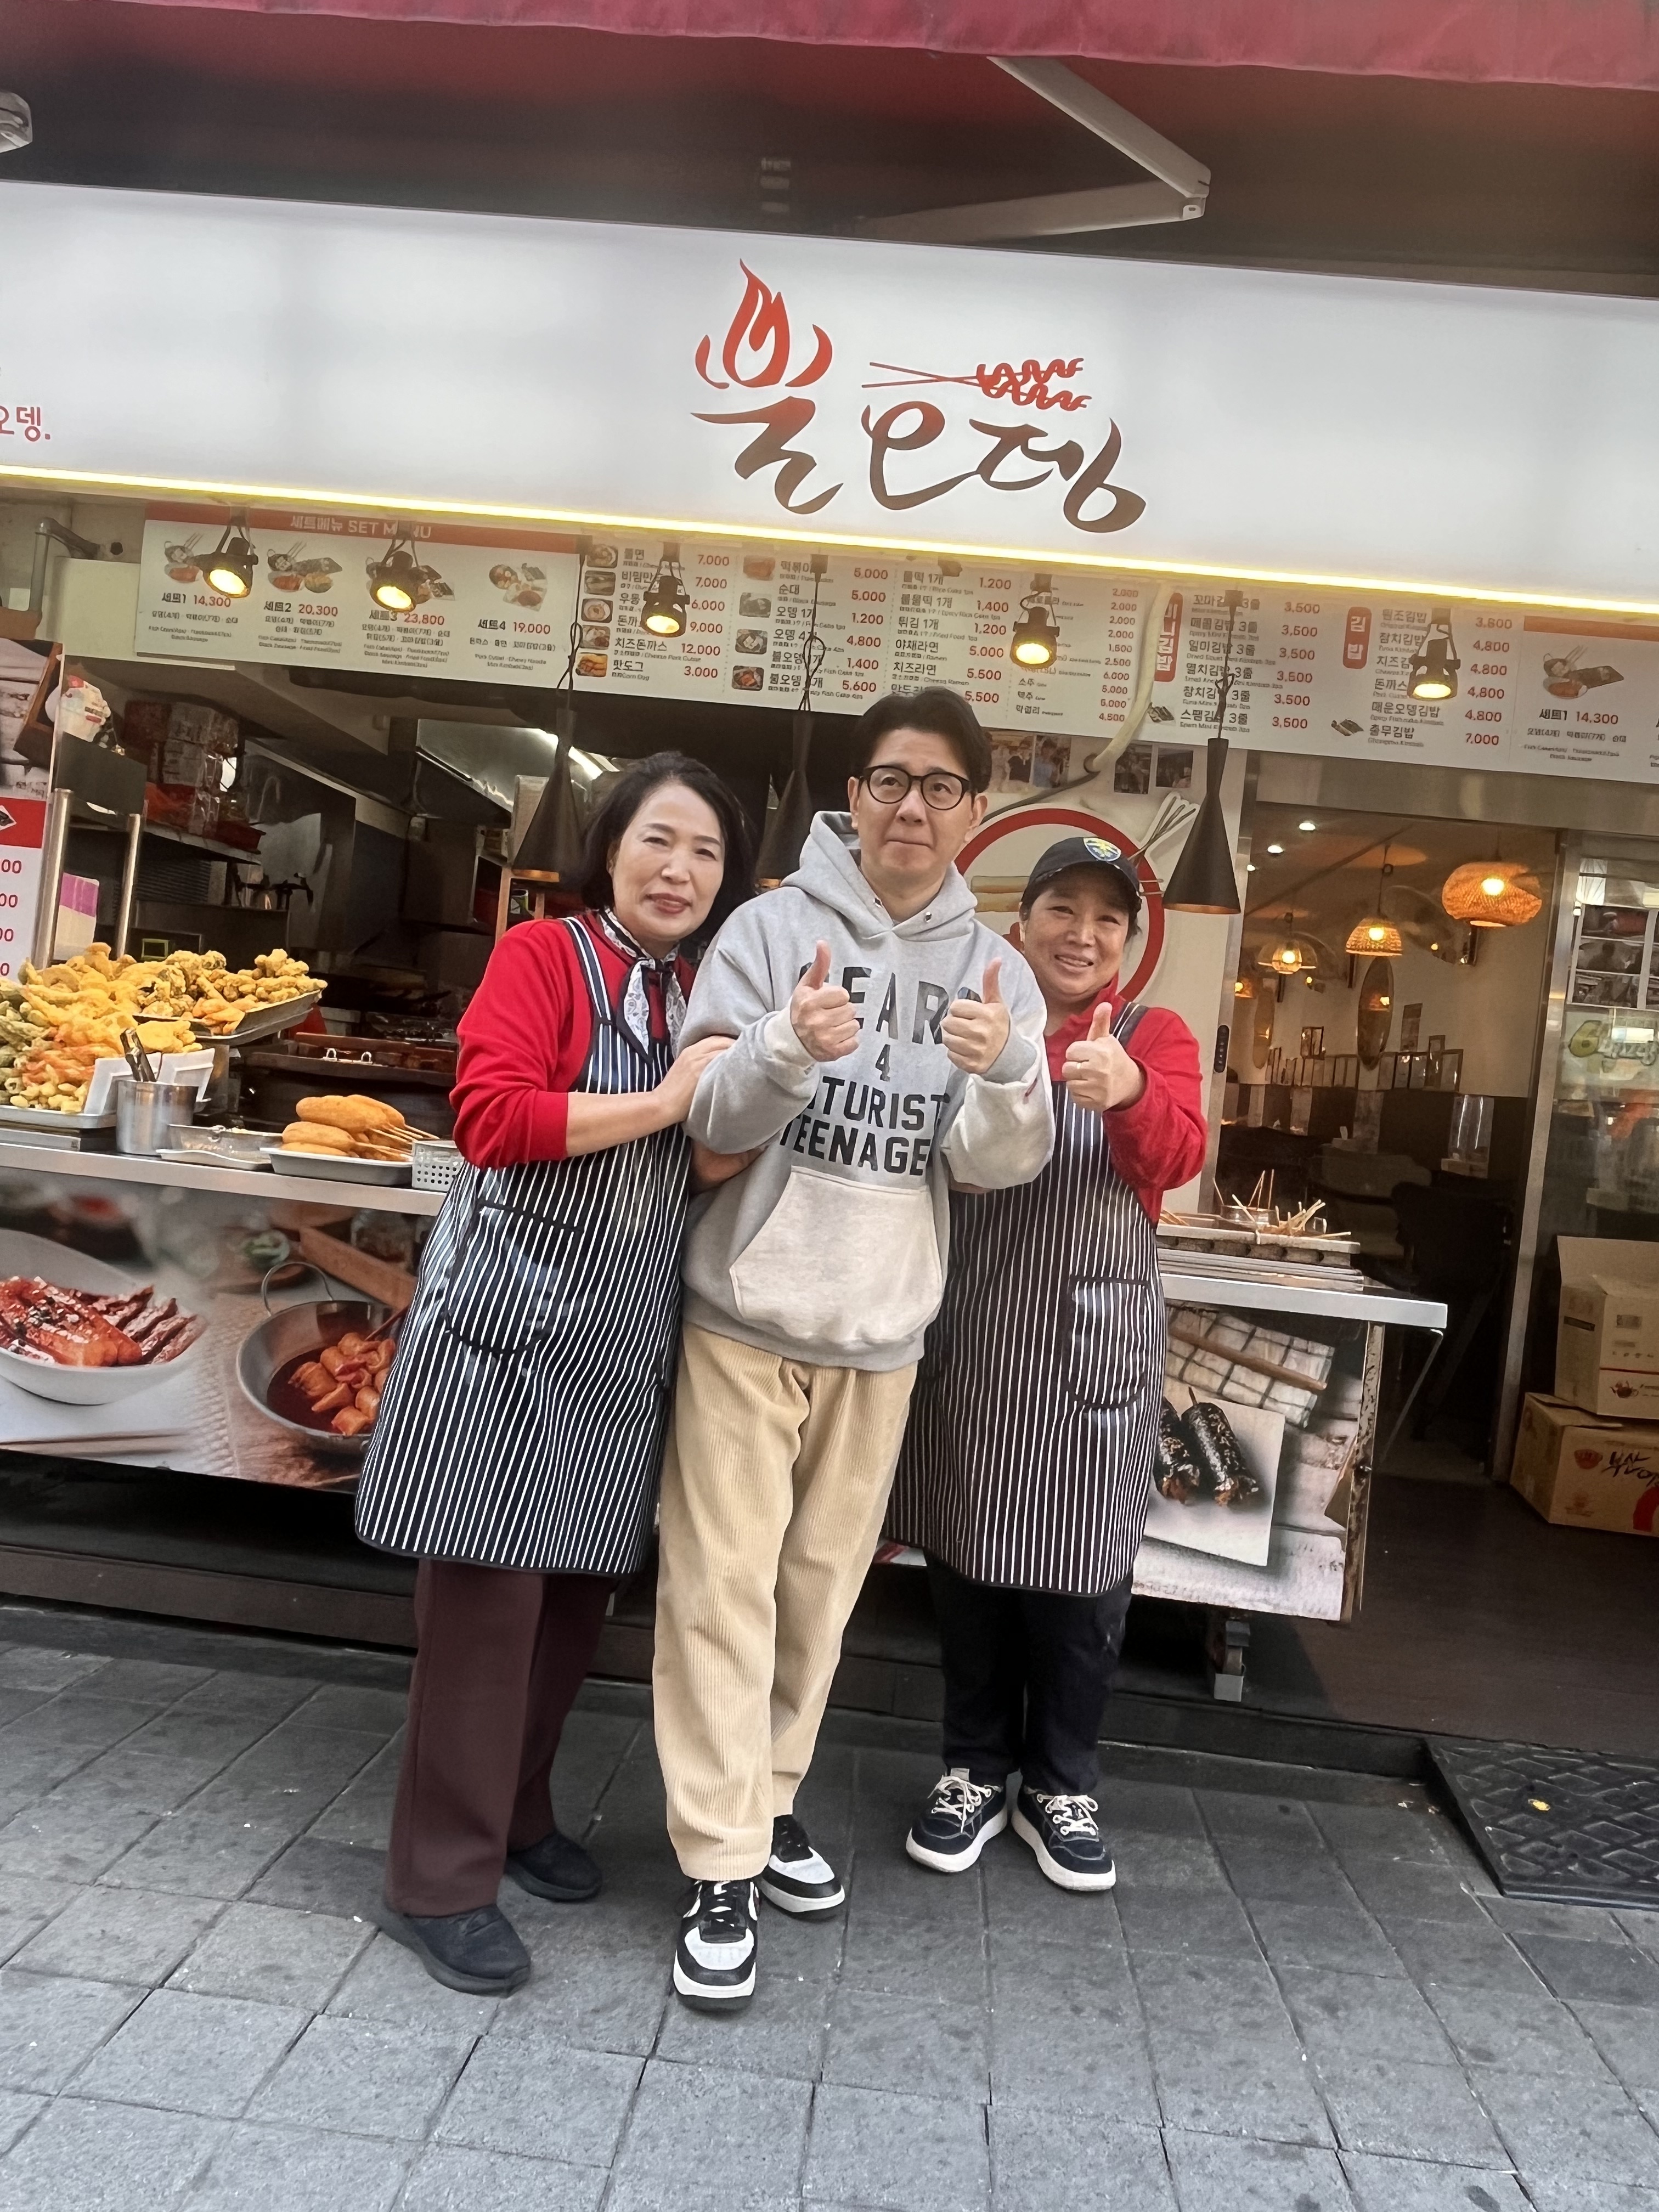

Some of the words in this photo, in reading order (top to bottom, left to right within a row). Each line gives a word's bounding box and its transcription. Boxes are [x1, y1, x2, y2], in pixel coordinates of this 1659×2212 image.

[348, 520, 379, 535] SET
[383, 522, 432, 538] MNU
[618, 615, 640, 627] 돈까
[614, 637, 667, 651] 치즈돈까스
[895, 639, 939, 653] 야채라면
[893, 662, 936, 676] 치즈라면
[1376, 656, 1409, 669] 치즈김
[1375, 678, 1407, 691] 돈까스
[1181, 709, 1216, 722] 스팸김
[798, 961, 982, 1045] EAR
[875, 1044, 891, 1082] 4
[807, 1076, 950, 1131] TURIST
[780, 1114, 937, 1176] TEENAGE
